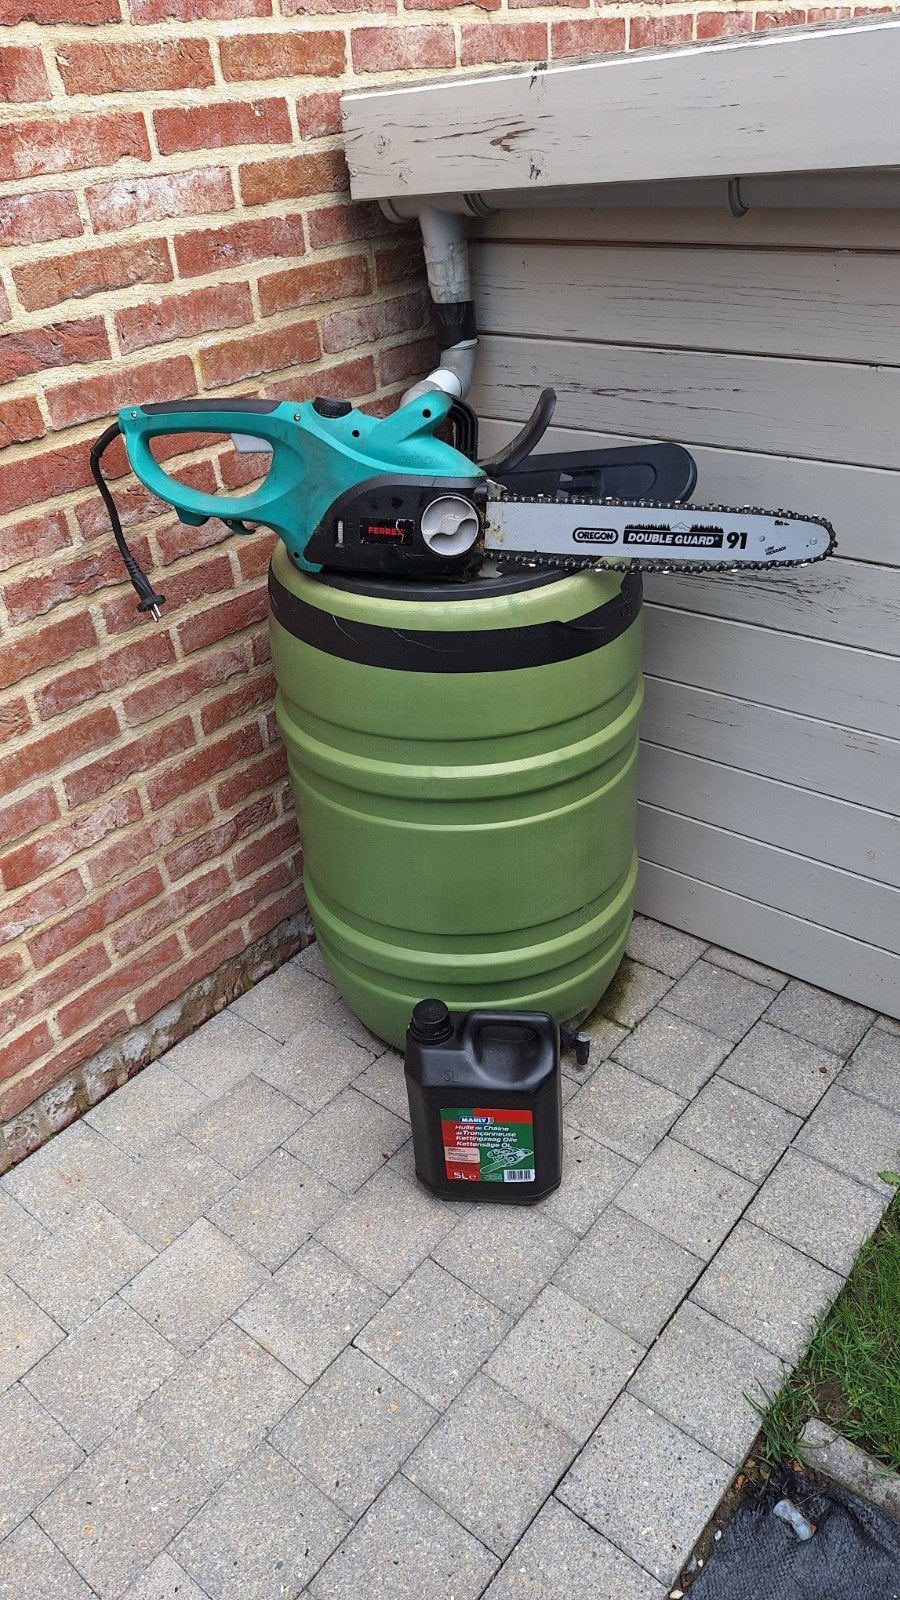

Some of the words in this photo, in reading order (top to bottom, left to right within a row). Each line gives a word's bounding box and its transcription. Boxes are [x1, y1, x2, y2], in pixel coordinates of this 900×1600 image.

[368, 526, 404, 536] FERREX
[577, 531, 614, 541] OREGON
[628, 532, 673, 544] DOUBLE
[726, 532, 748, 549] 91
